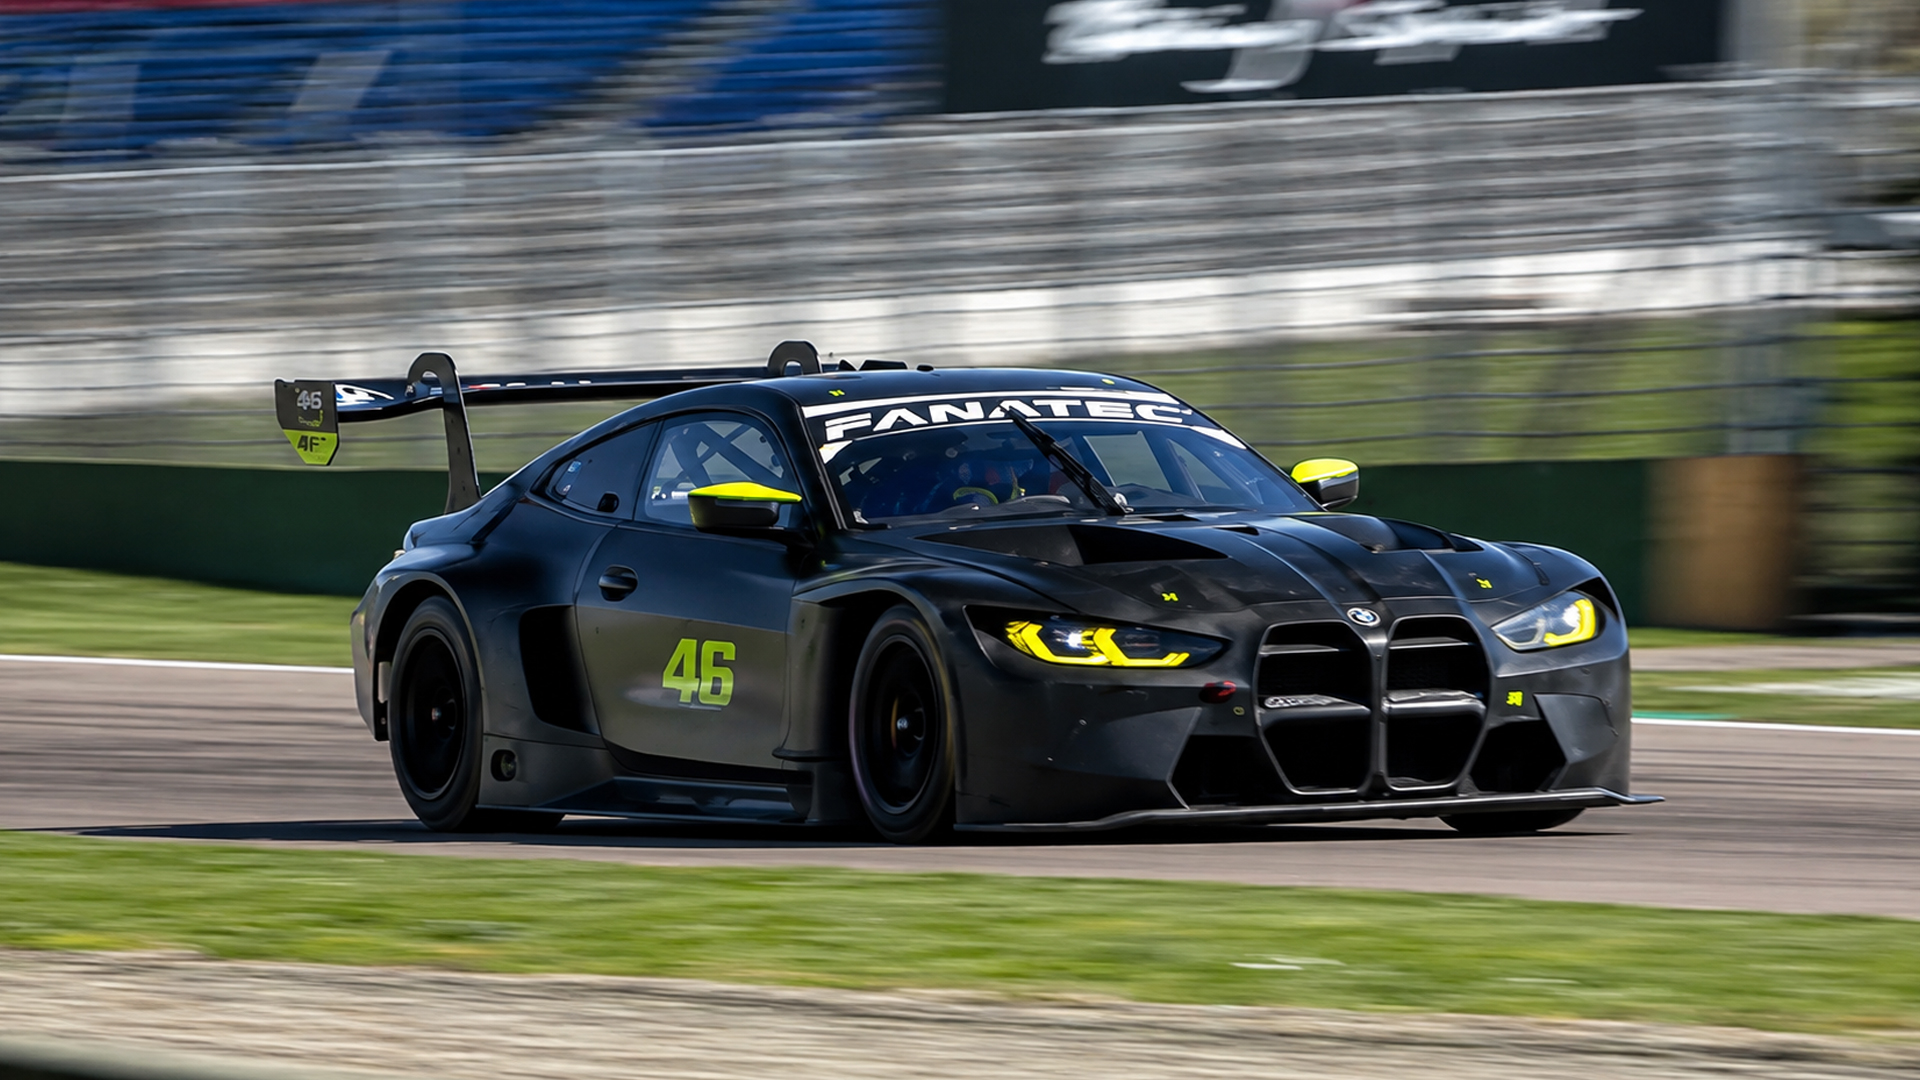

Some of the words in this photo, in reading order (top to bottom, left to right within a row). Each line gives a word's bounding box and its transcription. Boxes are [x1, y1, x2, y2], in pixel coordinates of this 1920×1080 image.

[297, 390, 322, 410] 46
[824, 400, 1191, 441] FANATEC
[662, 638, 735, 706] 46
